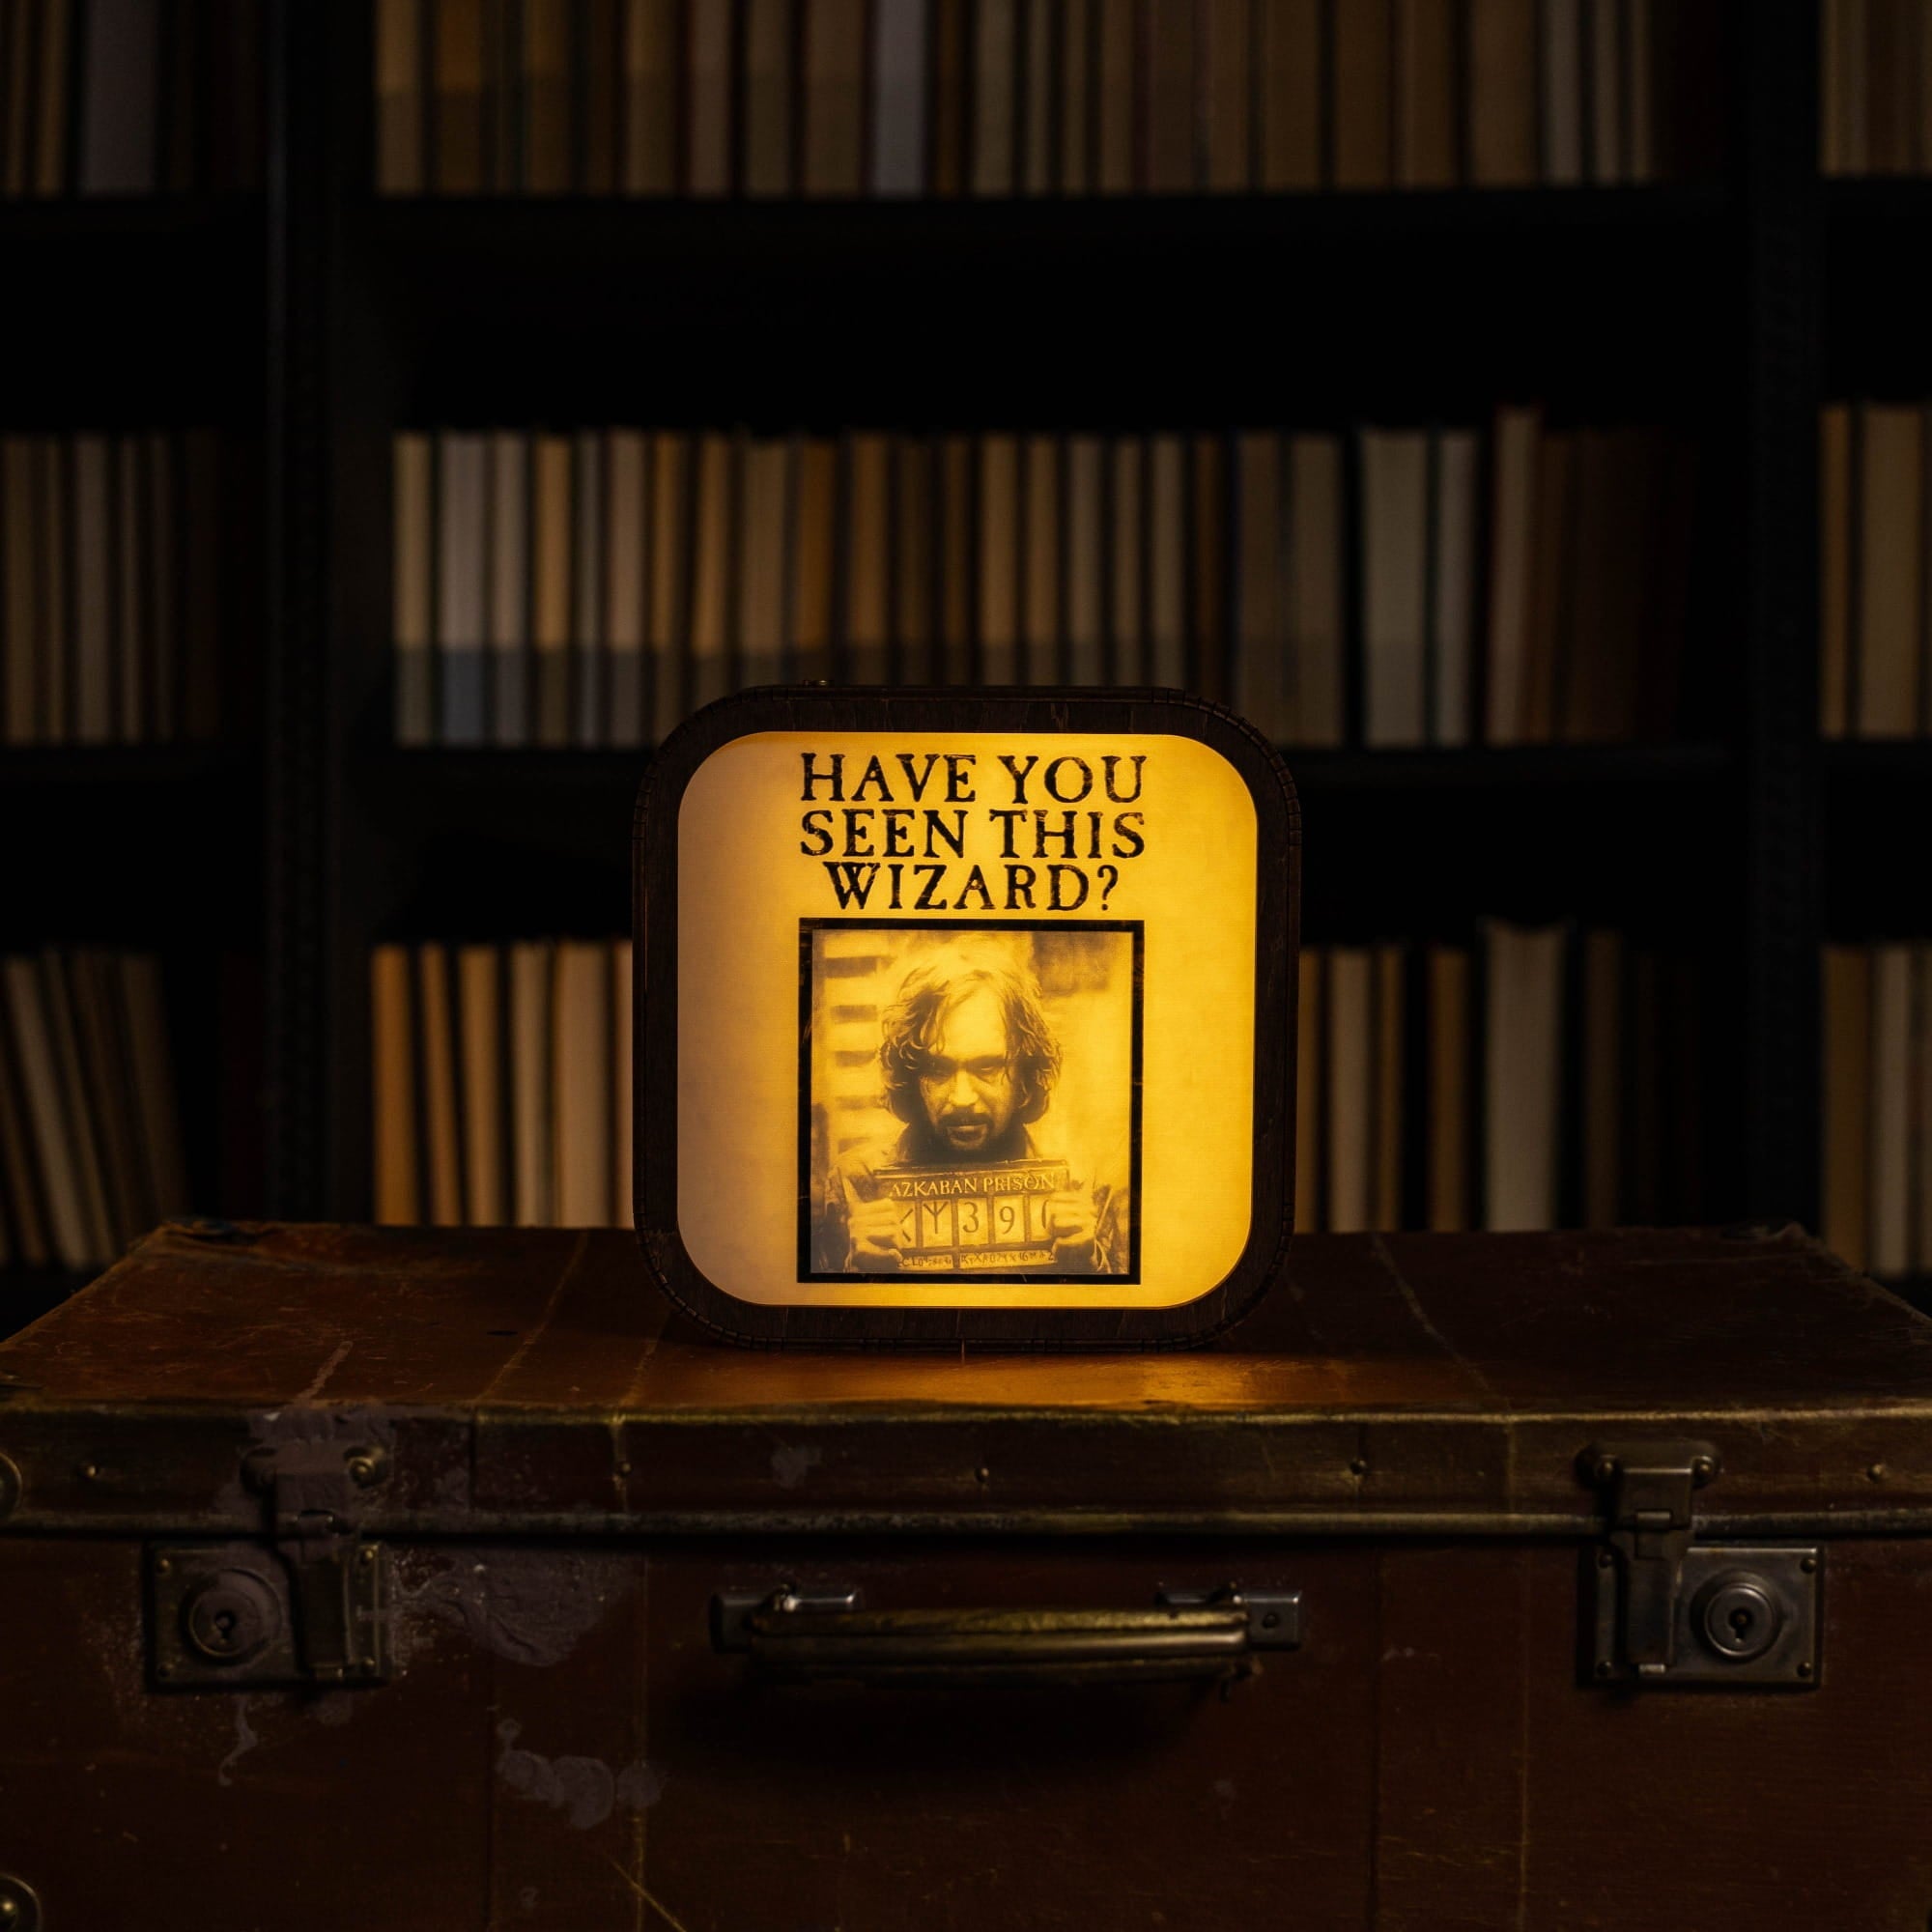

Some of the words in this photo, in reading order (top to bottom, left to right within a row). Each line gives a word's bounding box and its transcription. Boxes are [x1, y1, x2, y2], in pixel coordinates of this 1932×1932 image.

[800, 753, 977, 802] HAVE
[997, 755, 1148, 804] YOU
[800, 810, 969, 858] SEEN
[988, 810, 1146, 859] THIS
[823, 862, 1119, 911] WIZARD?
[891, 1178, 978, 1198] AZKABAN
[983, 1173, 1056, 1194] PRISON
